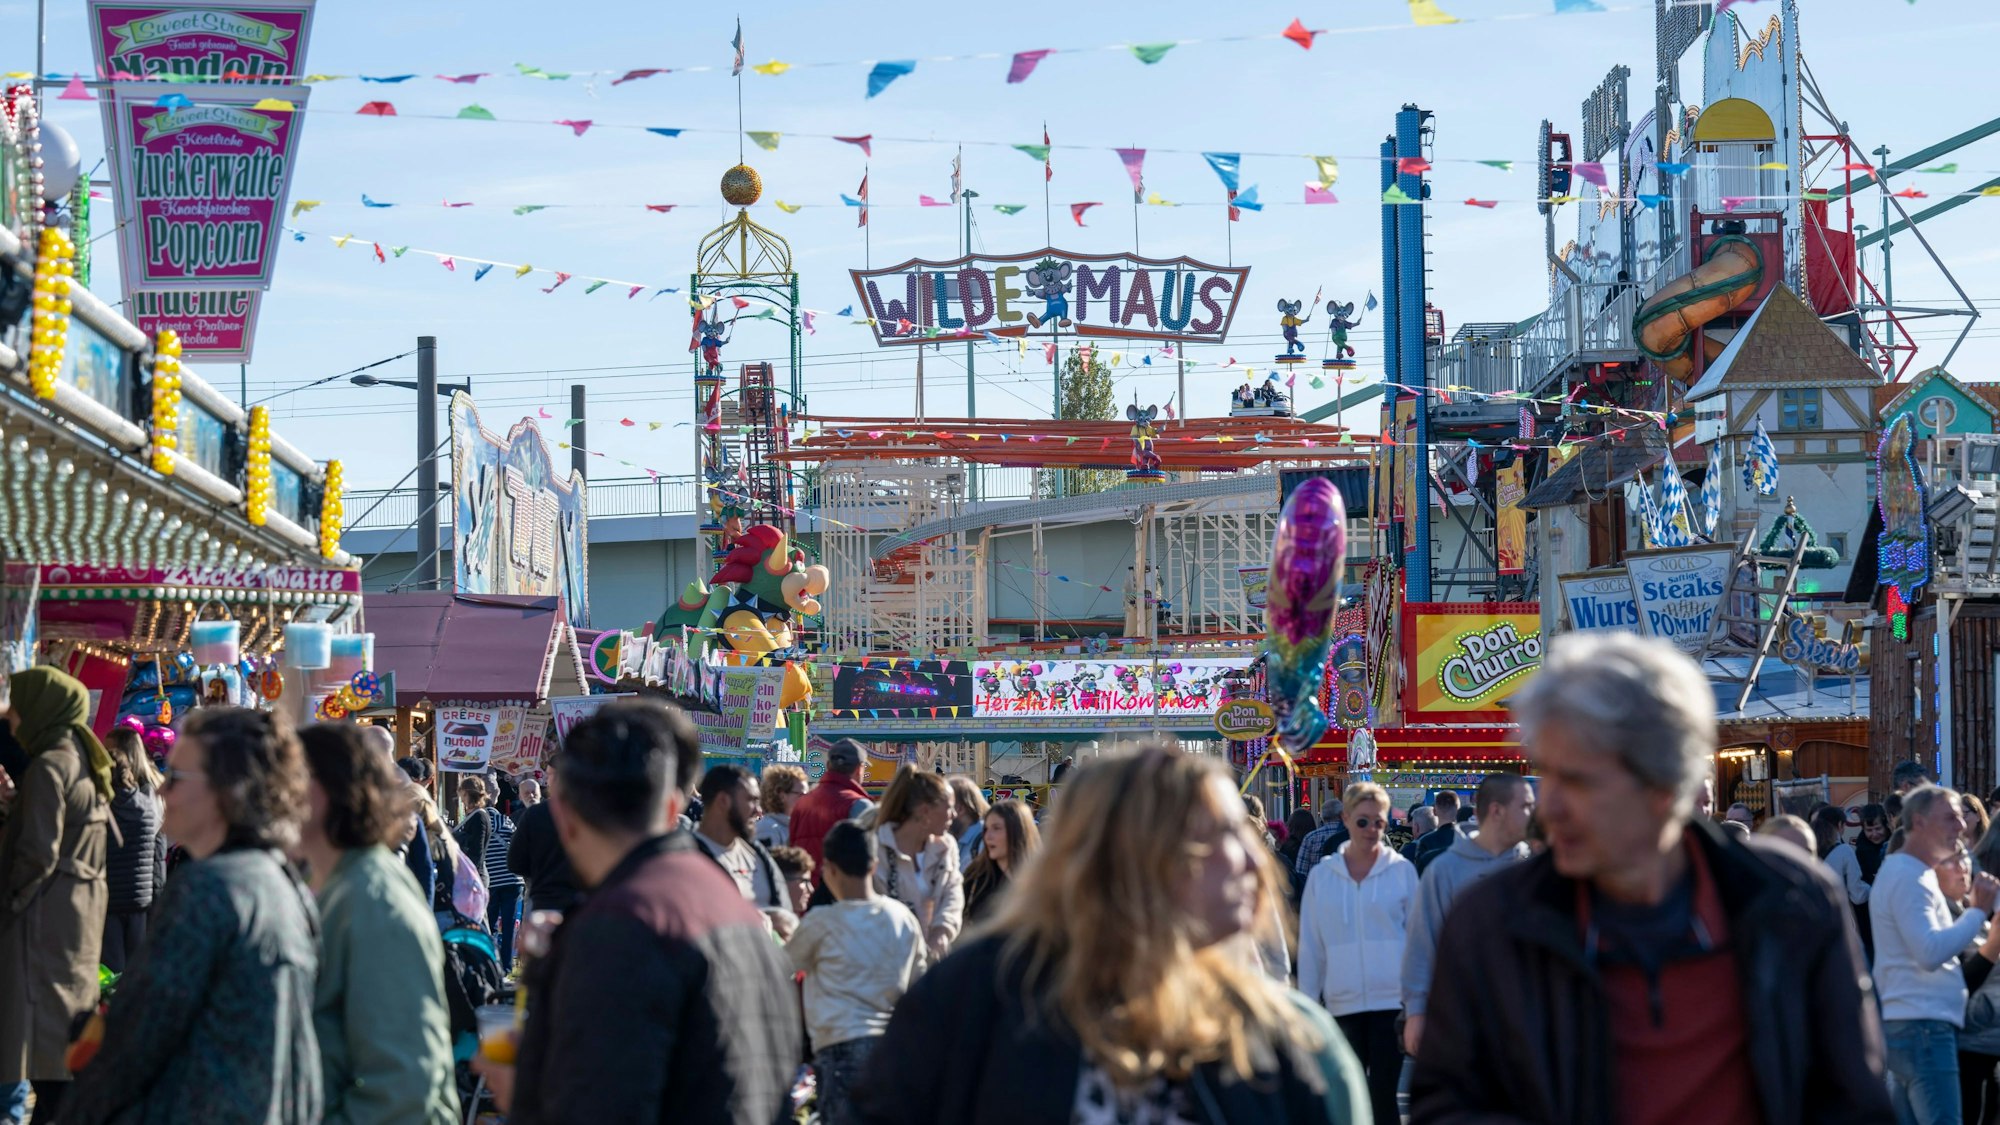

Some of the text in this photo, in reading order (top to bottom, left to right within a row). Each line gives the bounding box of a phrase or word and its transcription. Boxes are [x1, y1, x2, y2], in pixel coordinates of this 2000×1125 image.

[139, 13, 263, 39] Sweet Street
[111, 53, 287, 85] Mandeln
[161, 108, 260, 128] Sweet Street
[176, 133, 243, 146] Köstliche
[134, 146, 284, 198] Zuckerwatte
[160, 200, 251, 218] Knackfrisches
[149, 215, 261, 275] Popcorn
[865, 264, 1234, 337] WILDE MAUS
[144, 322, 153, 331] in
[193, 318, 244, 331] Pralinen-
[180, 332, 218, 344] okolade
[163, 563, 344, 590] Zuckerwatte
[1667, 572, 1699, 583] Saftige
[1643, 578, 1723, 601] Steaks
[1570, 596, 1638, 629] Wurs
[1461, 625, 1517, 660] Don
[1443, 636, 1540, 698] Churro
[757, 684, 775, 696] eln
[976, 691, 1065, 711] Herzlich
[1072, 689, 1207, 711] Willkommen
[723, 693, 750, 708] gnons
[755, 700, 776, 711] ko-
[442, 708, 491, 723] CRÊPES
[1219, 711, 1271, 731] Churros
[1232, 706, 1256, 717] Don
[1342, 717, 1368, 728] POLICE
[444, 735, 485, 747] nutella
[516, 732, 541, 758] eln
